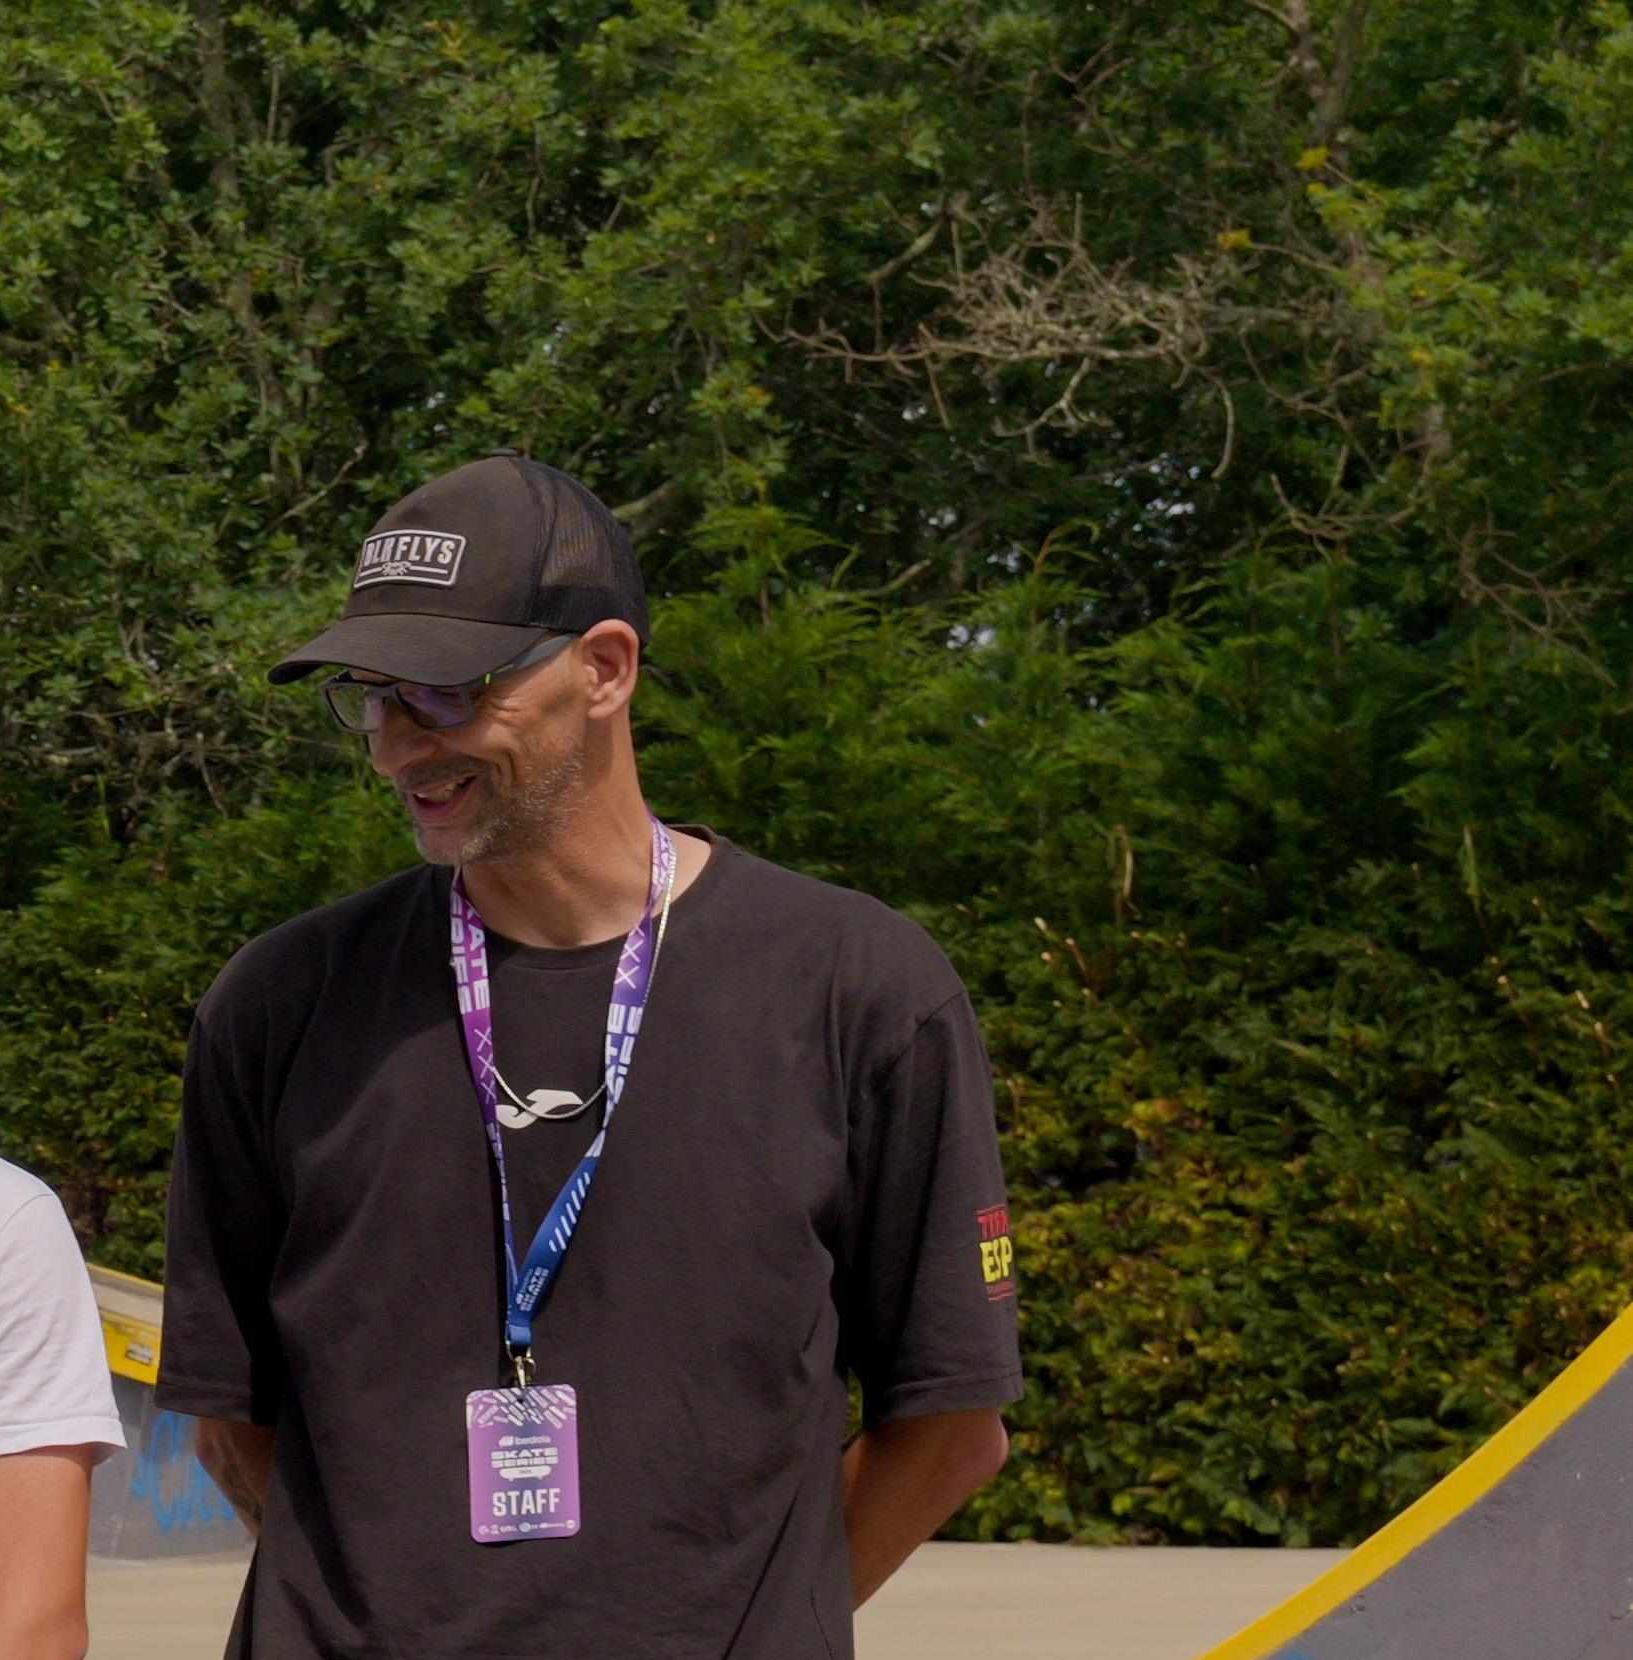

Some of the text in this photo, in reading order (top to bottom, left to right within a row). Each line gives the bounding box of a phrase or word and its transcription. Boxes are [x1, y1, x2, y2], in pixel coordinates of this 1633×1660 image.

[491, 1447, 558, 1459] SKATE
[491, 1457, 559, 1468] SERIES
[493, 1488, 561, 1517] STAFF
